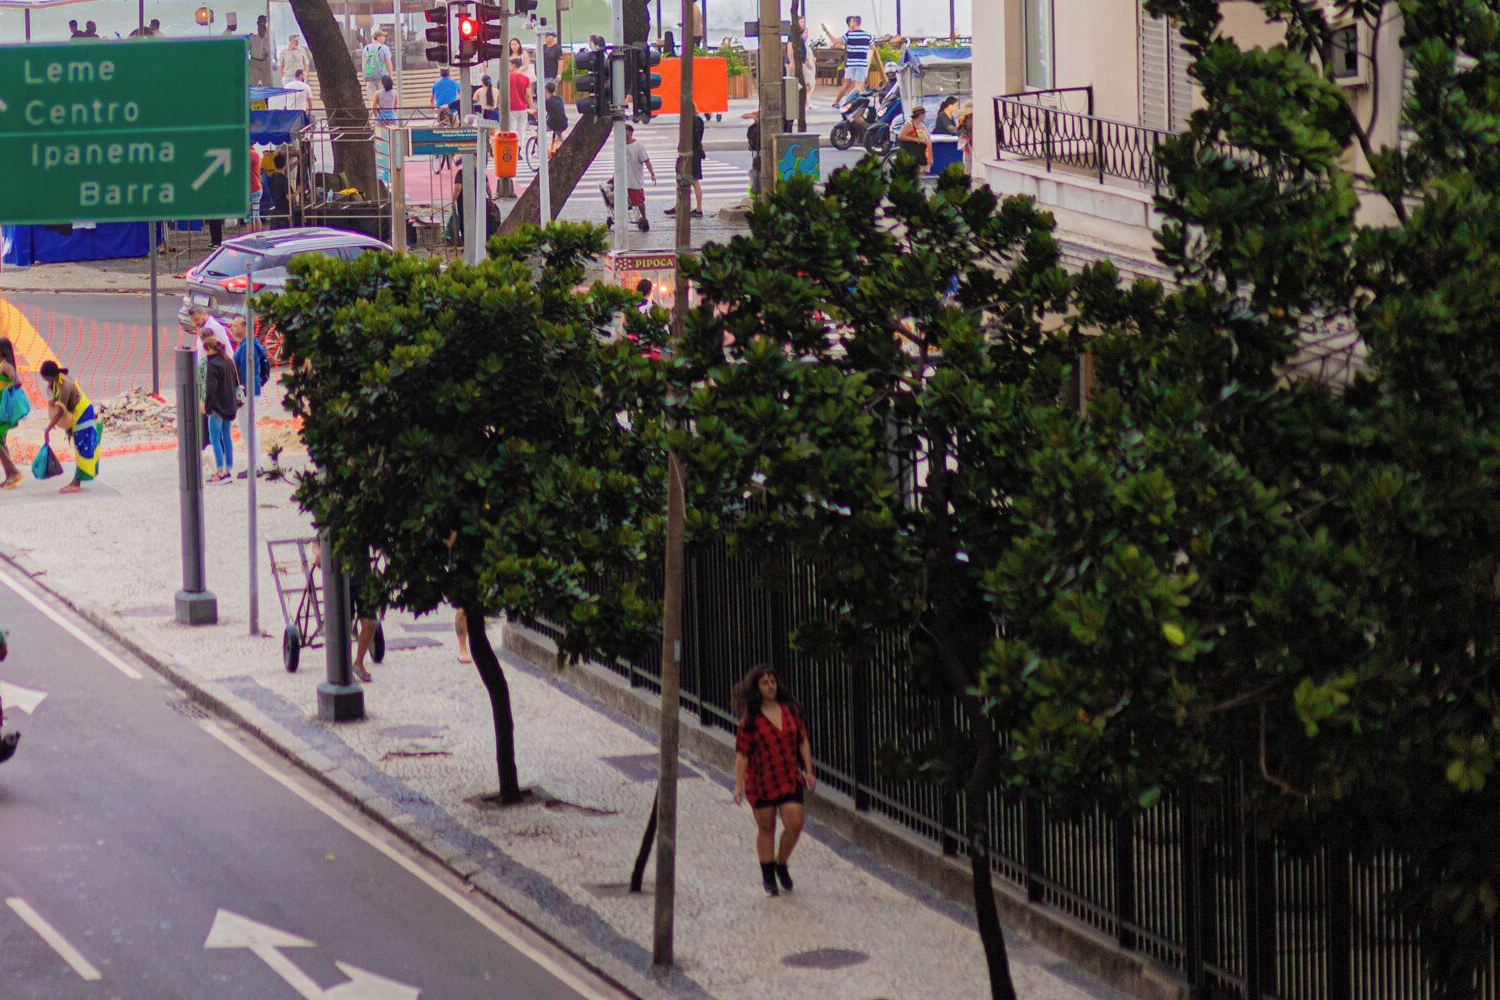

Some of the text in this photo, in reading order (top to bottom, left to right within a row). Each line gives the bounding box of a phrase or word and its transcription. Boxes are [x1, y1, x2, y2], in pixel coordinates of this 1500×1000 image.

[25, 60, 115, 84] Leme
[25, 100, 139, 125] Centro
[31, 142, 175, 168] Ipanema
[80, 182, 175, 206] Barra
[635, 258, 674, 268] PIPOCA
